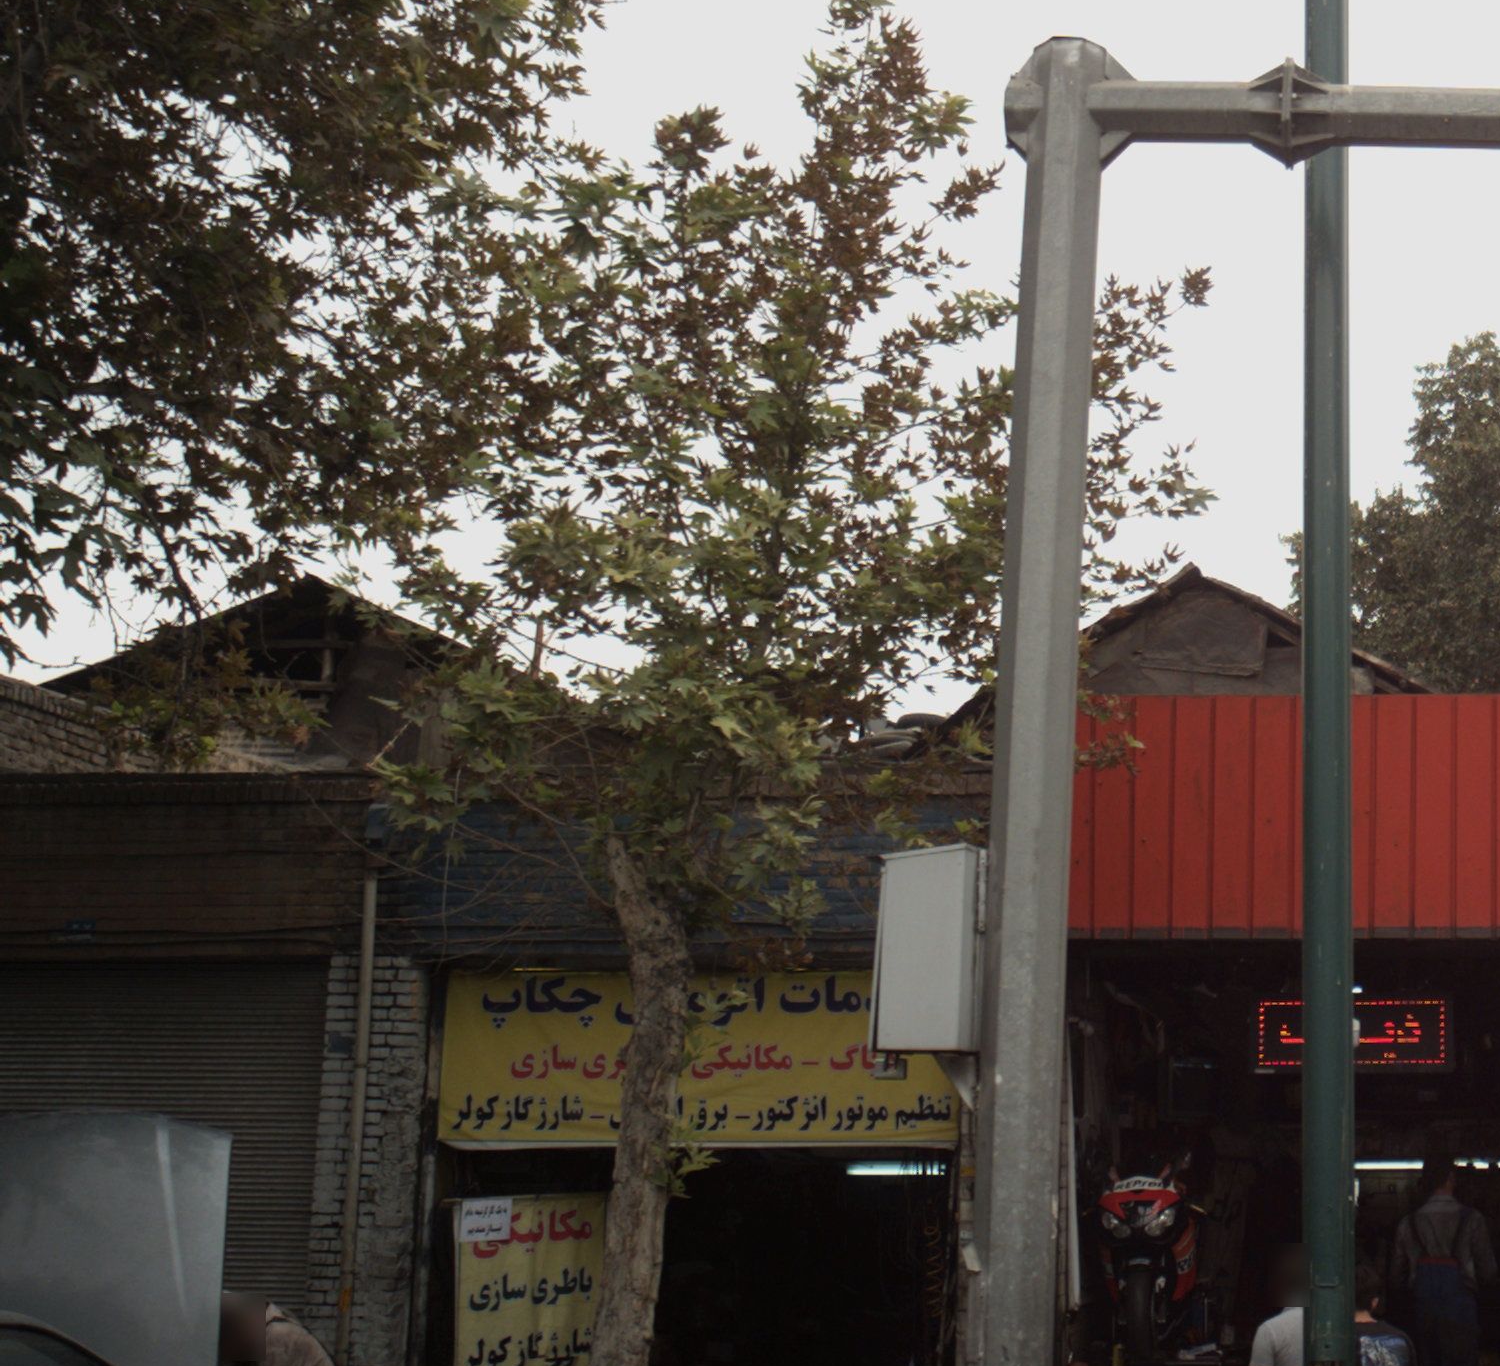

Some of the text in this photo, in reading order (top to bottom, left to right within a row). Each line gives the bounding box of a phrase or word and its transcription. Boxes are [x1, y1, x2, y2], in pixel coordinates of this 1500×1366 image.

[482, 976, 602, 1029] چکاپ
[780, 975, 871, 1014] مات
[511, 1043, 577, 1079] سازی
[691, 1044, 792, 1079] مکانیکی
[452, 1094, 499, 1130] کولر
[500, 1095, 534, 1130] گاز
[536, 1095, 584, 1130] شارژ
[832, 1096, 888, 1131] موتور
[895, 1095, 951, 1130] تنظیم
[469, 1267, 593, 1312] باطری سازی
